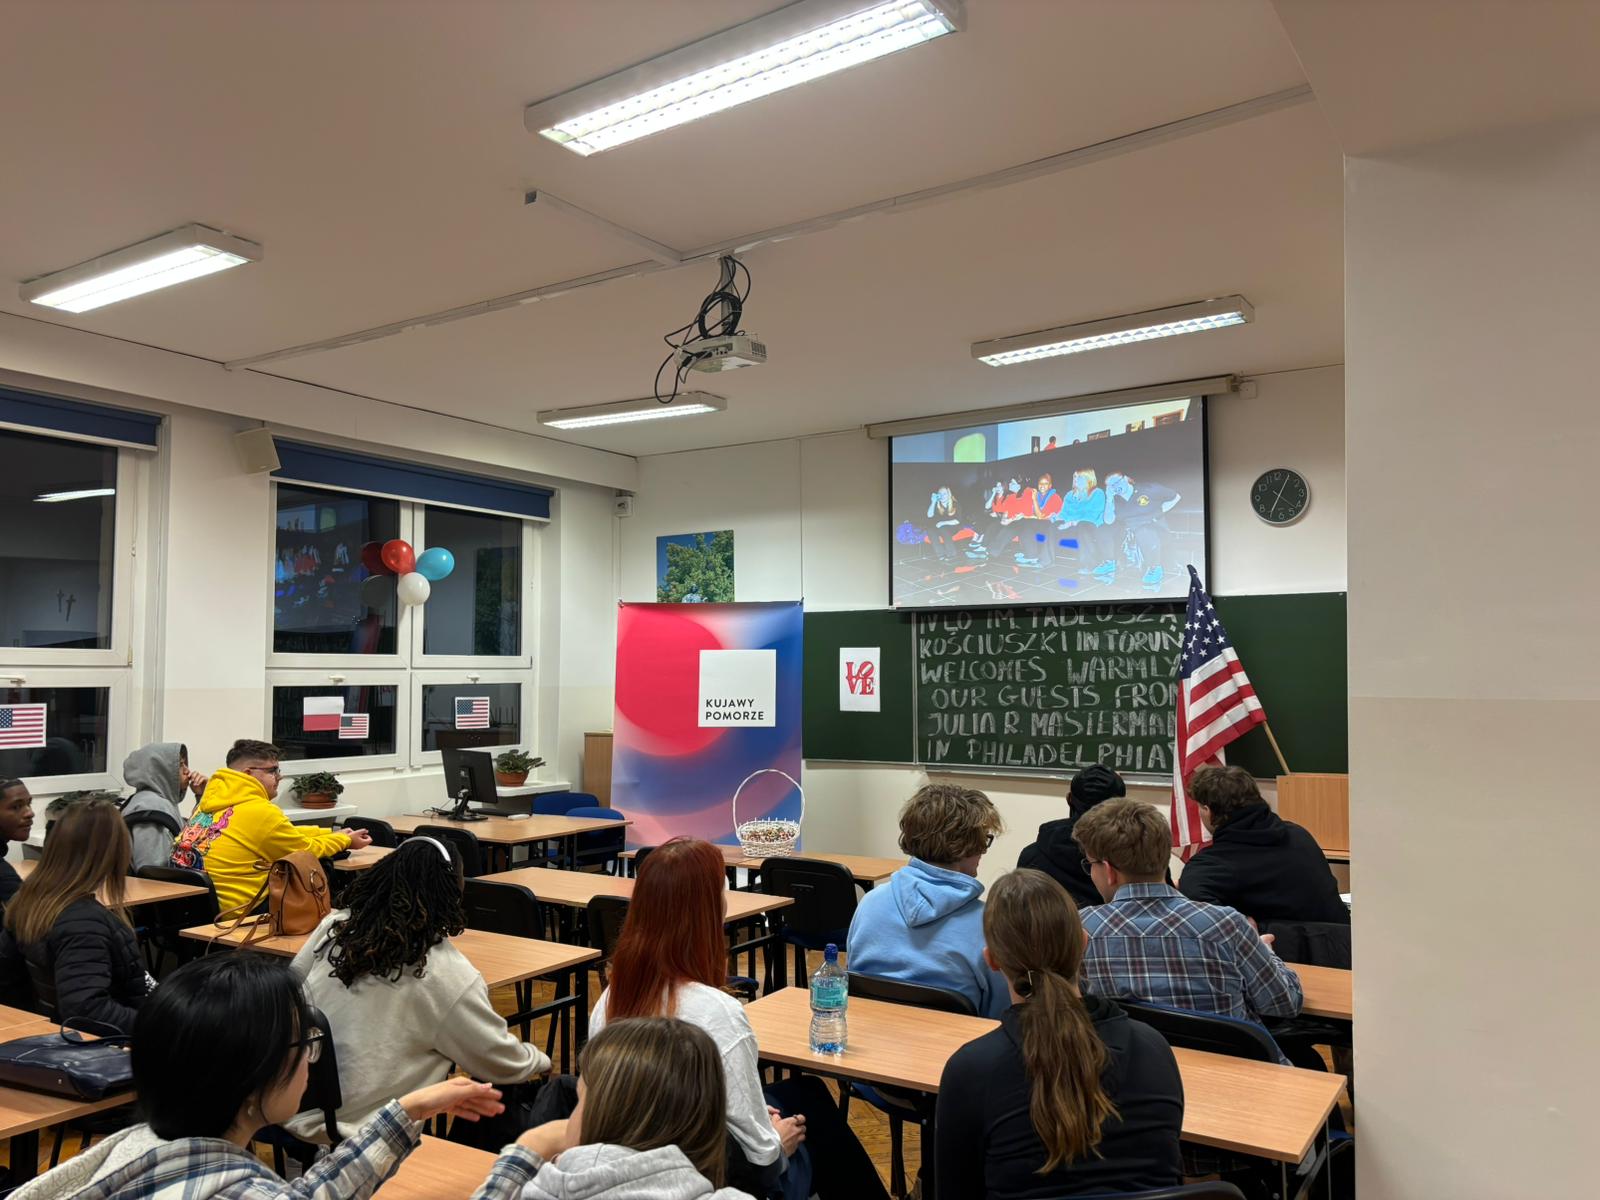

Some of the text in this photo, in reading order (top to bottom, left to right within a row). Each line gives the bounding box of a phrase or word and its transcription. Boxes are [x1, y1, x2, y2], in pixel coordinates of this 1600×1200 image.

[1076, 630, 1100, 652] IN
[920, 653, 1182, 685] WELCOMES WARMLY
[705, 698, 755, 708] KUJAWY
[931, 686, 988, 710] OUR
[998, 684, 1101, 709] GUESTS
[705, 710, 765, 721] POMORZE
[927, 711, 997, 737] JULIA
[927, 739, 951, 762] IN
